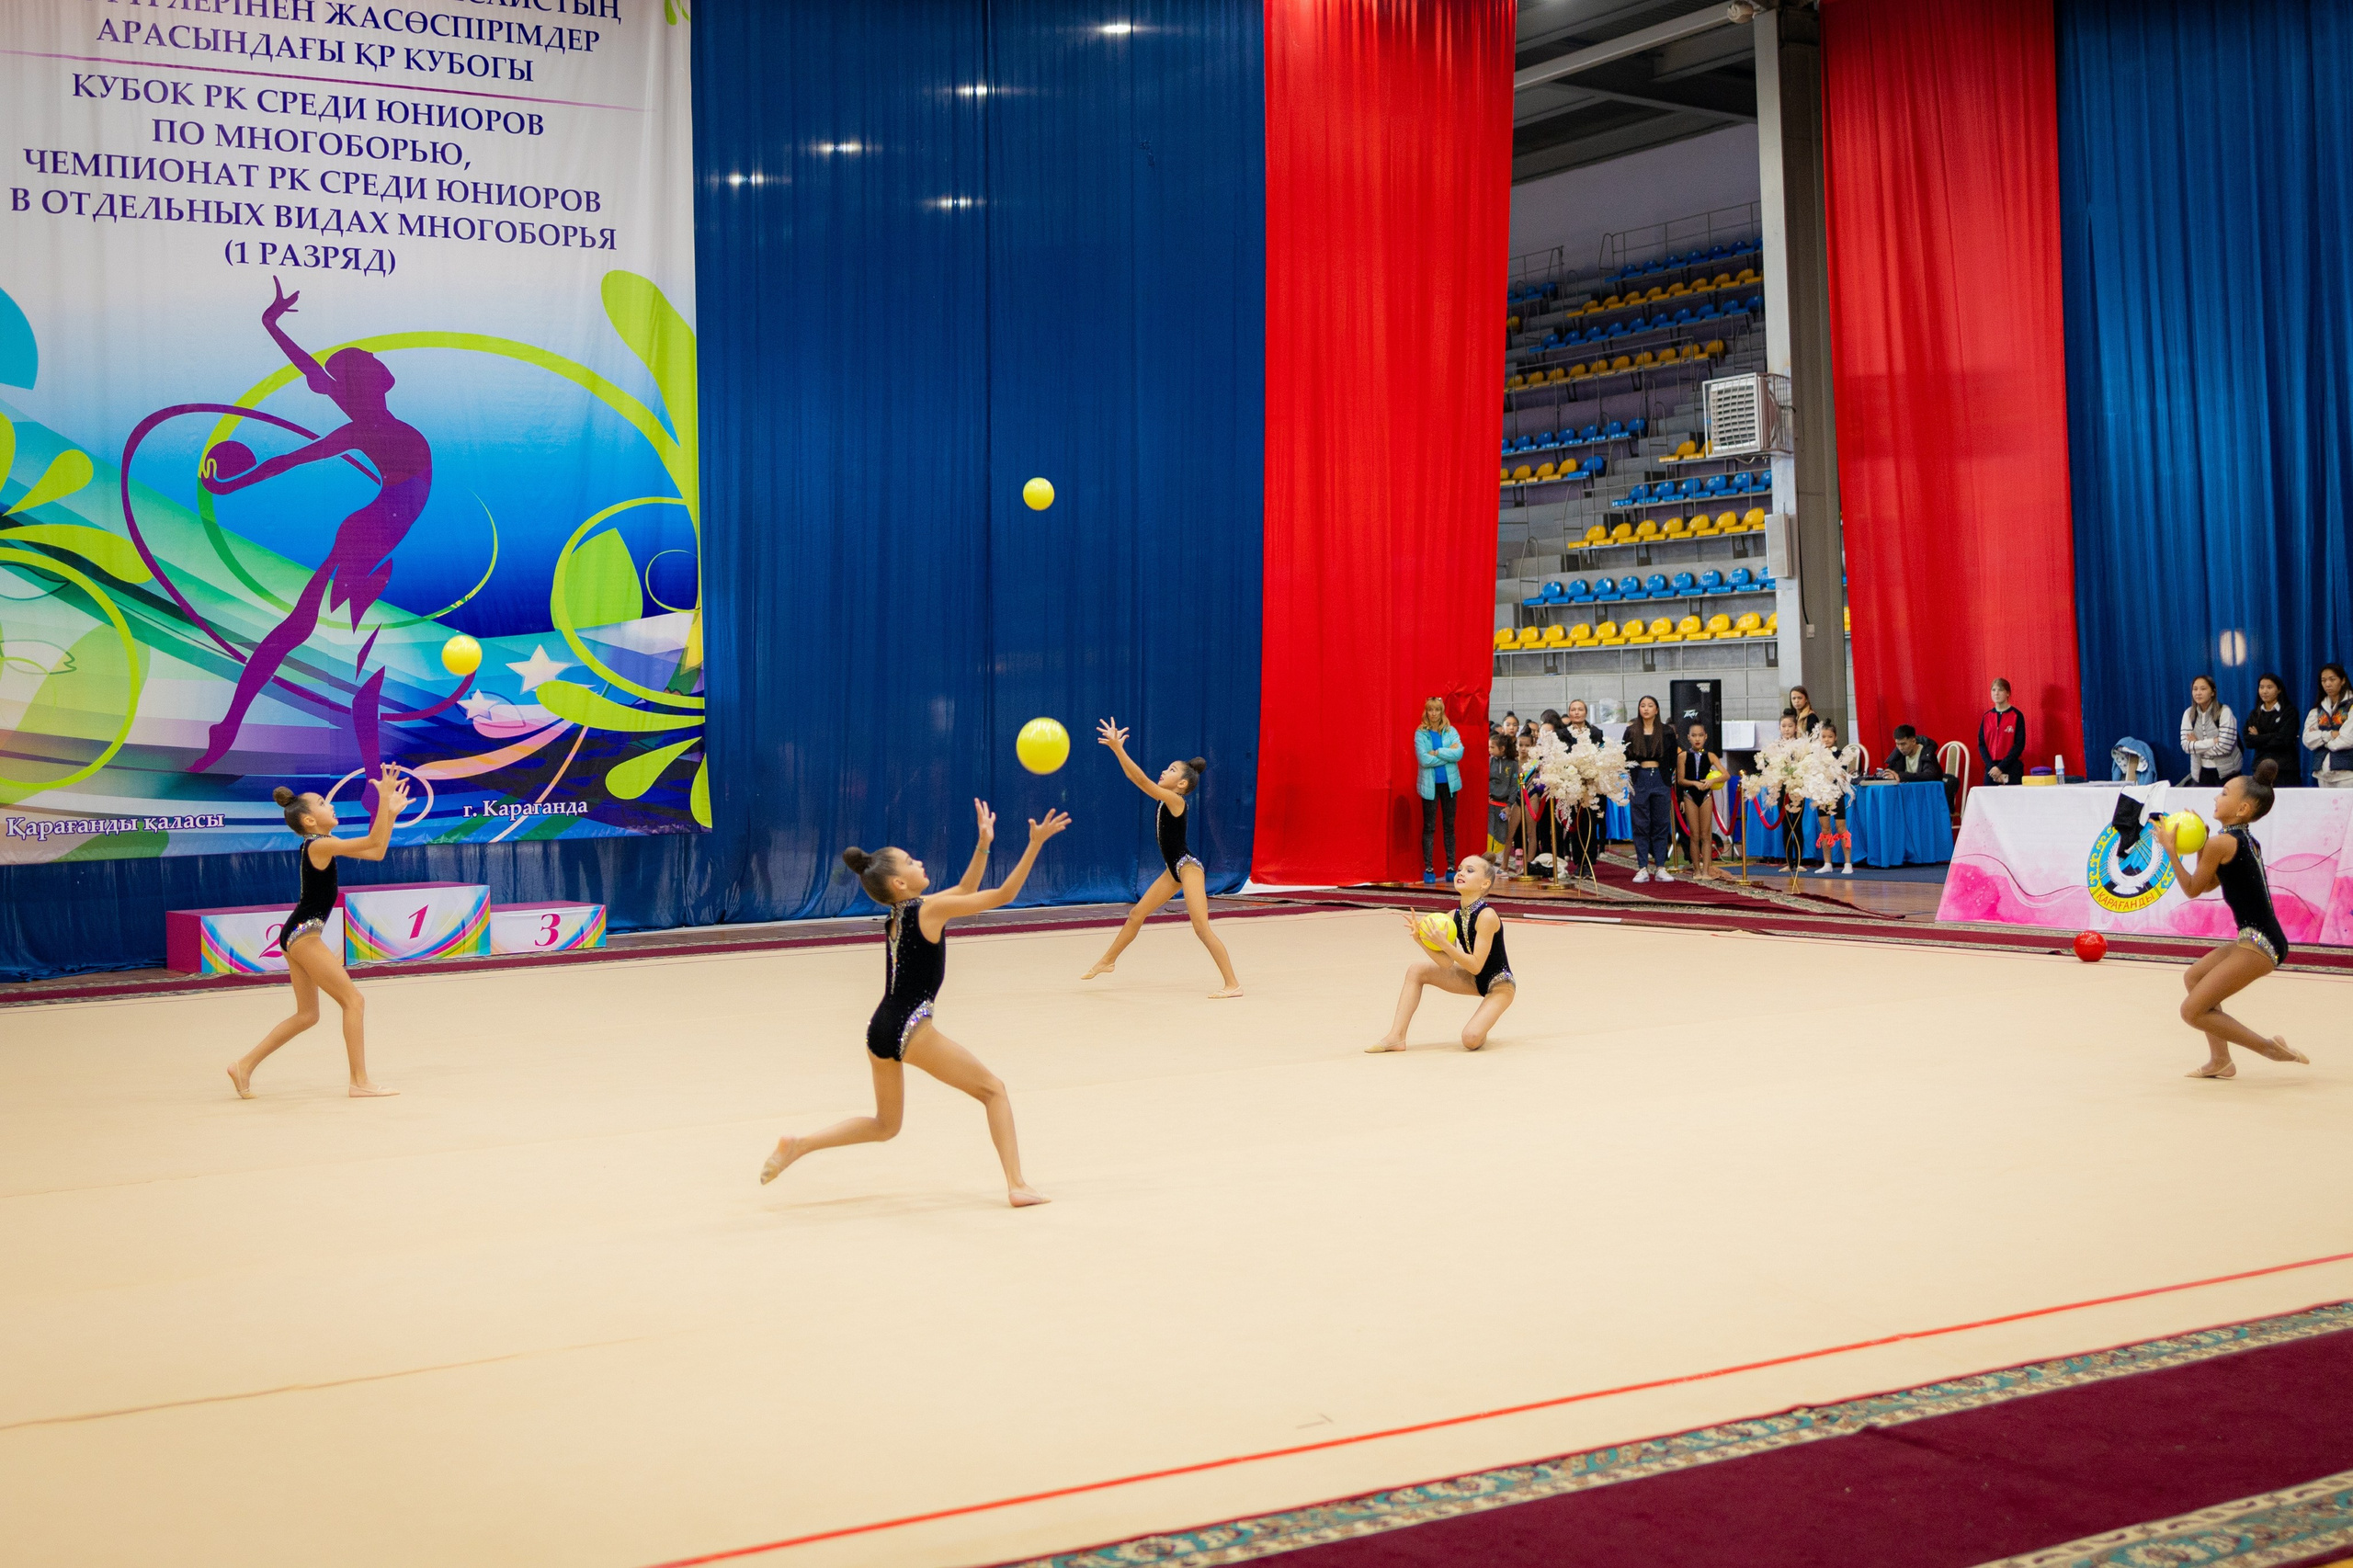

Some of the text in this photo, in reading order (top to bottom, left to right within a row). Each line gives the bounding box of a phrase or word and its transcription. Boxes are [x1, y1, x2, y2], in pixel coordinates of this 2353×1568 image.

[97, 18, 534, 82] АРАСЫНДАҒЫ ҚР КУБОГЫ
[324, 2, 600, 54] ЖАСӨСПІРІМДЕР
[73, 73, 544, 136] КУБОК РК СРЕДИ ЮНИОРОВ
[152, 119, 472, 170] ПО МНОГОБОРЬЮ,
[23, 148, 601, 212] ЧЕМПИОНАТ РК СРЕДИ ЮНИОРОВ
[10, 187, 617, 250] В ОТДЕЛЬНЫХ ВИДАХ МНОГОБОРЬЯ
[225, 240, 395, 278] (1 РАЗРЯД)
[6, 813, 224, 841] Қарағанды қаласы
[462, 800, 588, 822] г. Караганда
[258, 923, 284, 959] 2
[408, 903, 429, 939] 1
[534, 913, 561, 947] 3
